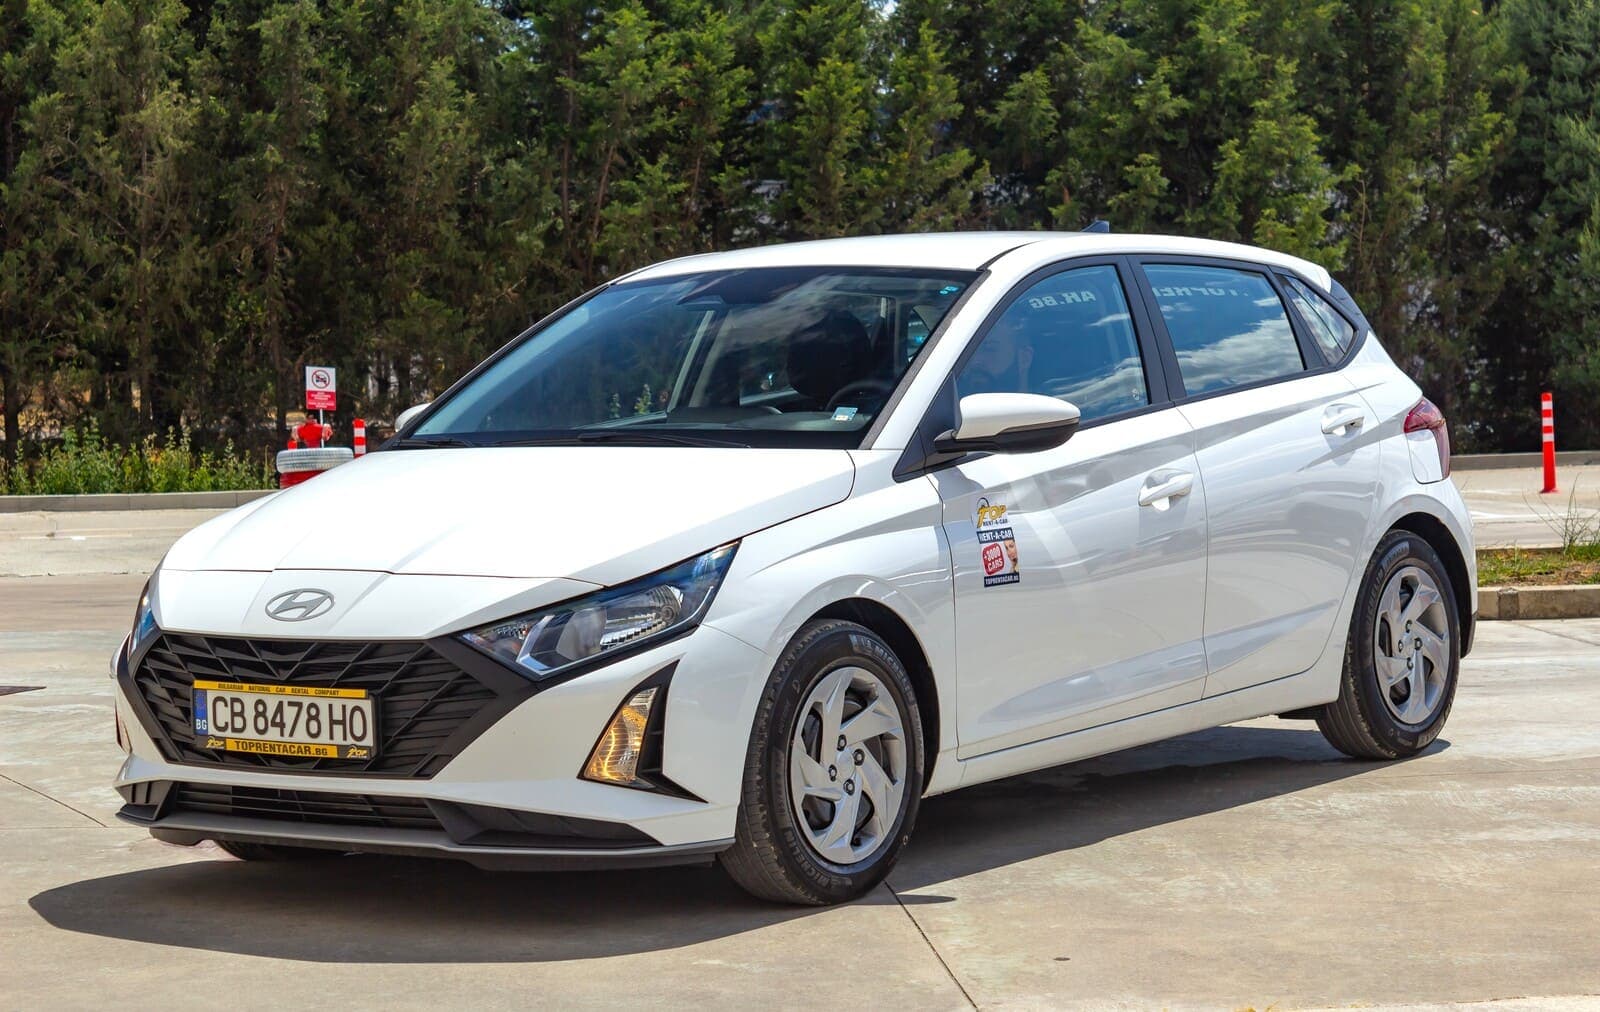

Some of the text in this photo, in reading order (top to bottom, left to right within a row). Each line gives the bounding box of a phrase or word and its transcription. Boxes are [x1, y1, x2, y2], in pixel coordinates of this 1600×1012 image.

[977, 504, 1007, 528] TOP
[987, 558, 1004, 572] CARS
[195, 718, 208, 731] BG
[212, 695, 247, 734] CB
[253, 698, 322, 739] 8478
[235, 740, 328, 756] TOPRENTACAR.BG
